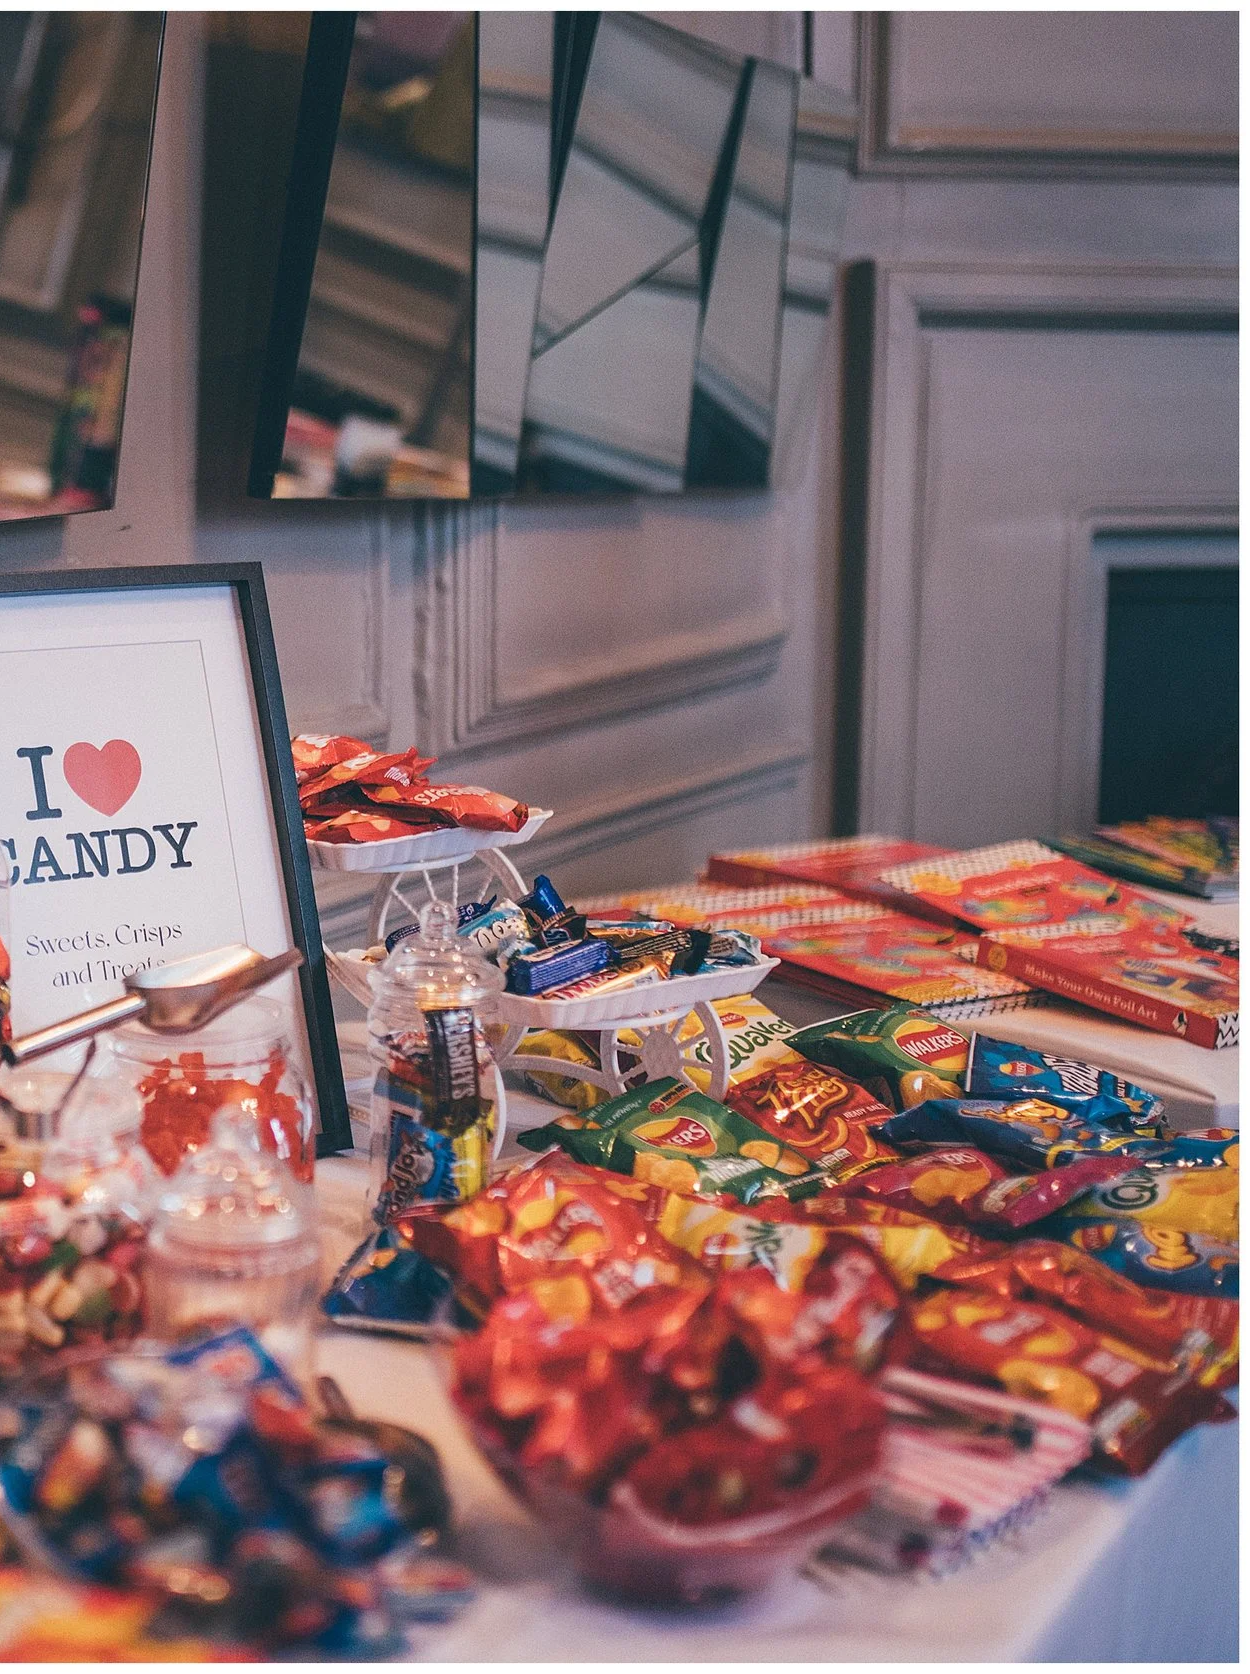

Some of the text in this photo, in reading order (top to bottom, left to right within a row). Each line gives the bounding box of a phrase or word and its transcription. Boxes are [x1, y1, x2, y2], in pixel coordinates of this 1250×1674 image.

[16, 745, 63, 821] I
[115, 922, 183, 947] Crisps
[52, 961, 93, 988] and
[1024, 964, 1159, 1021] Make Your Own Foil Art
[902, 1031, 964, 1057] WALKERS
